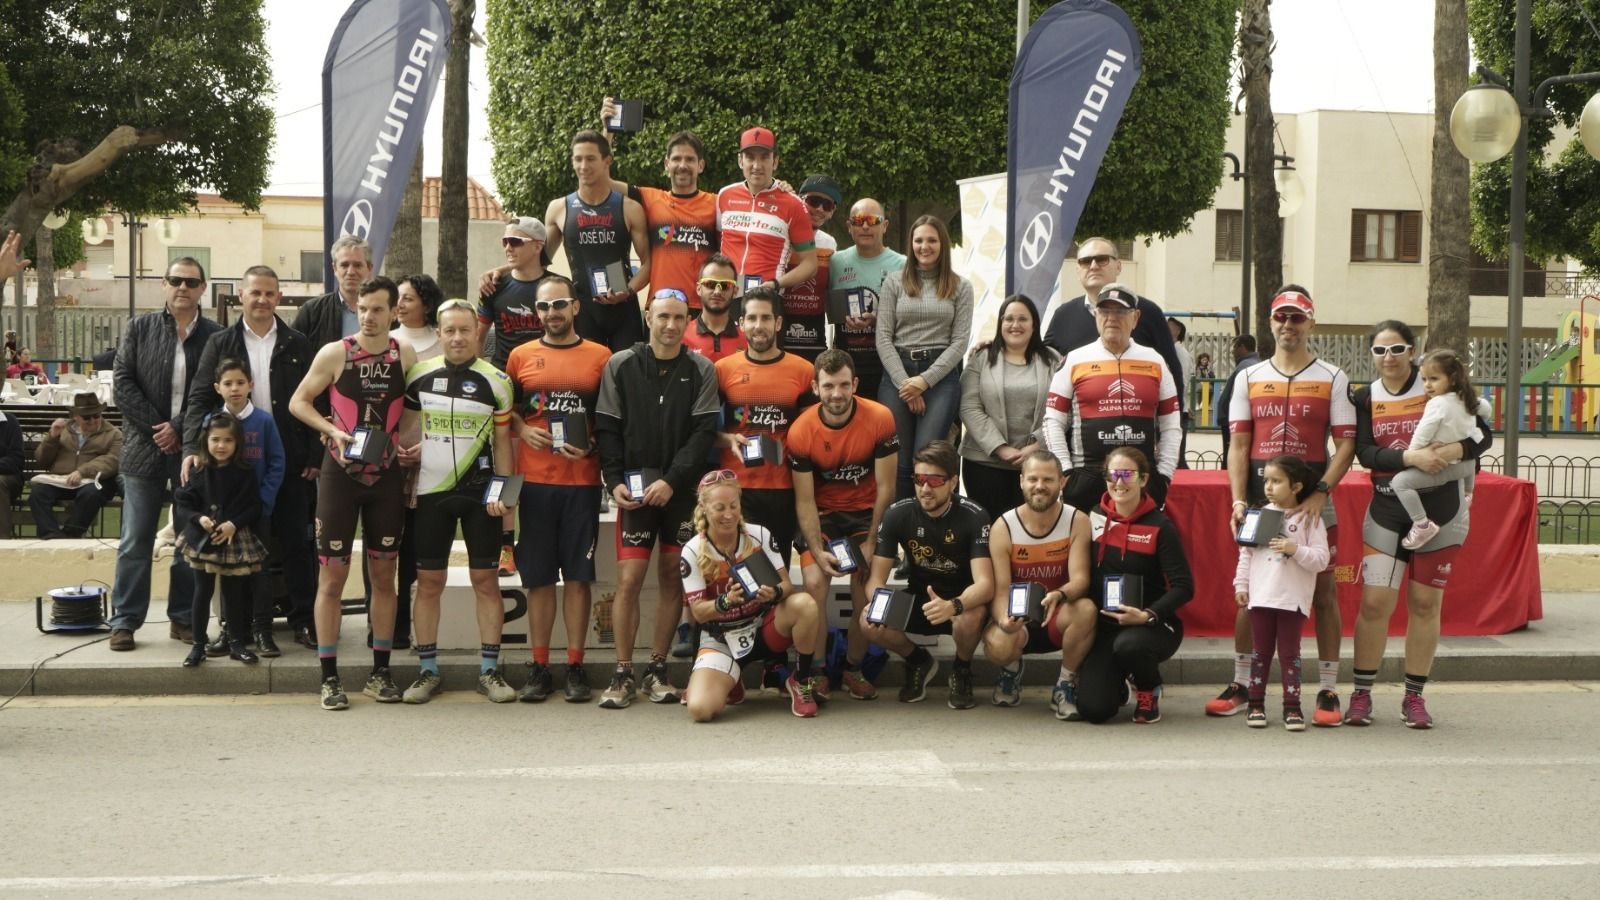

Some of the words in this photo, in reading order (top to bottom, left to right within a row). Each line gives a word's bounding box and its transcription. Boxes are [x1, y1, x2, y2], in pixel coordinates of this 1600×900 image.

[360, 27, 439, 194] HYUNDAI
[1043, 48, 1127, 207] HYUNDAI
[578, 229, 598, 244] JOSÉ
[599, 229, 616, 244] DÍAZ
[360, 363, 391, 378] DIAZ
[1257, 402, 1283, 417] IVÁN
[1016, 565, 1062, 578] JUANMA
